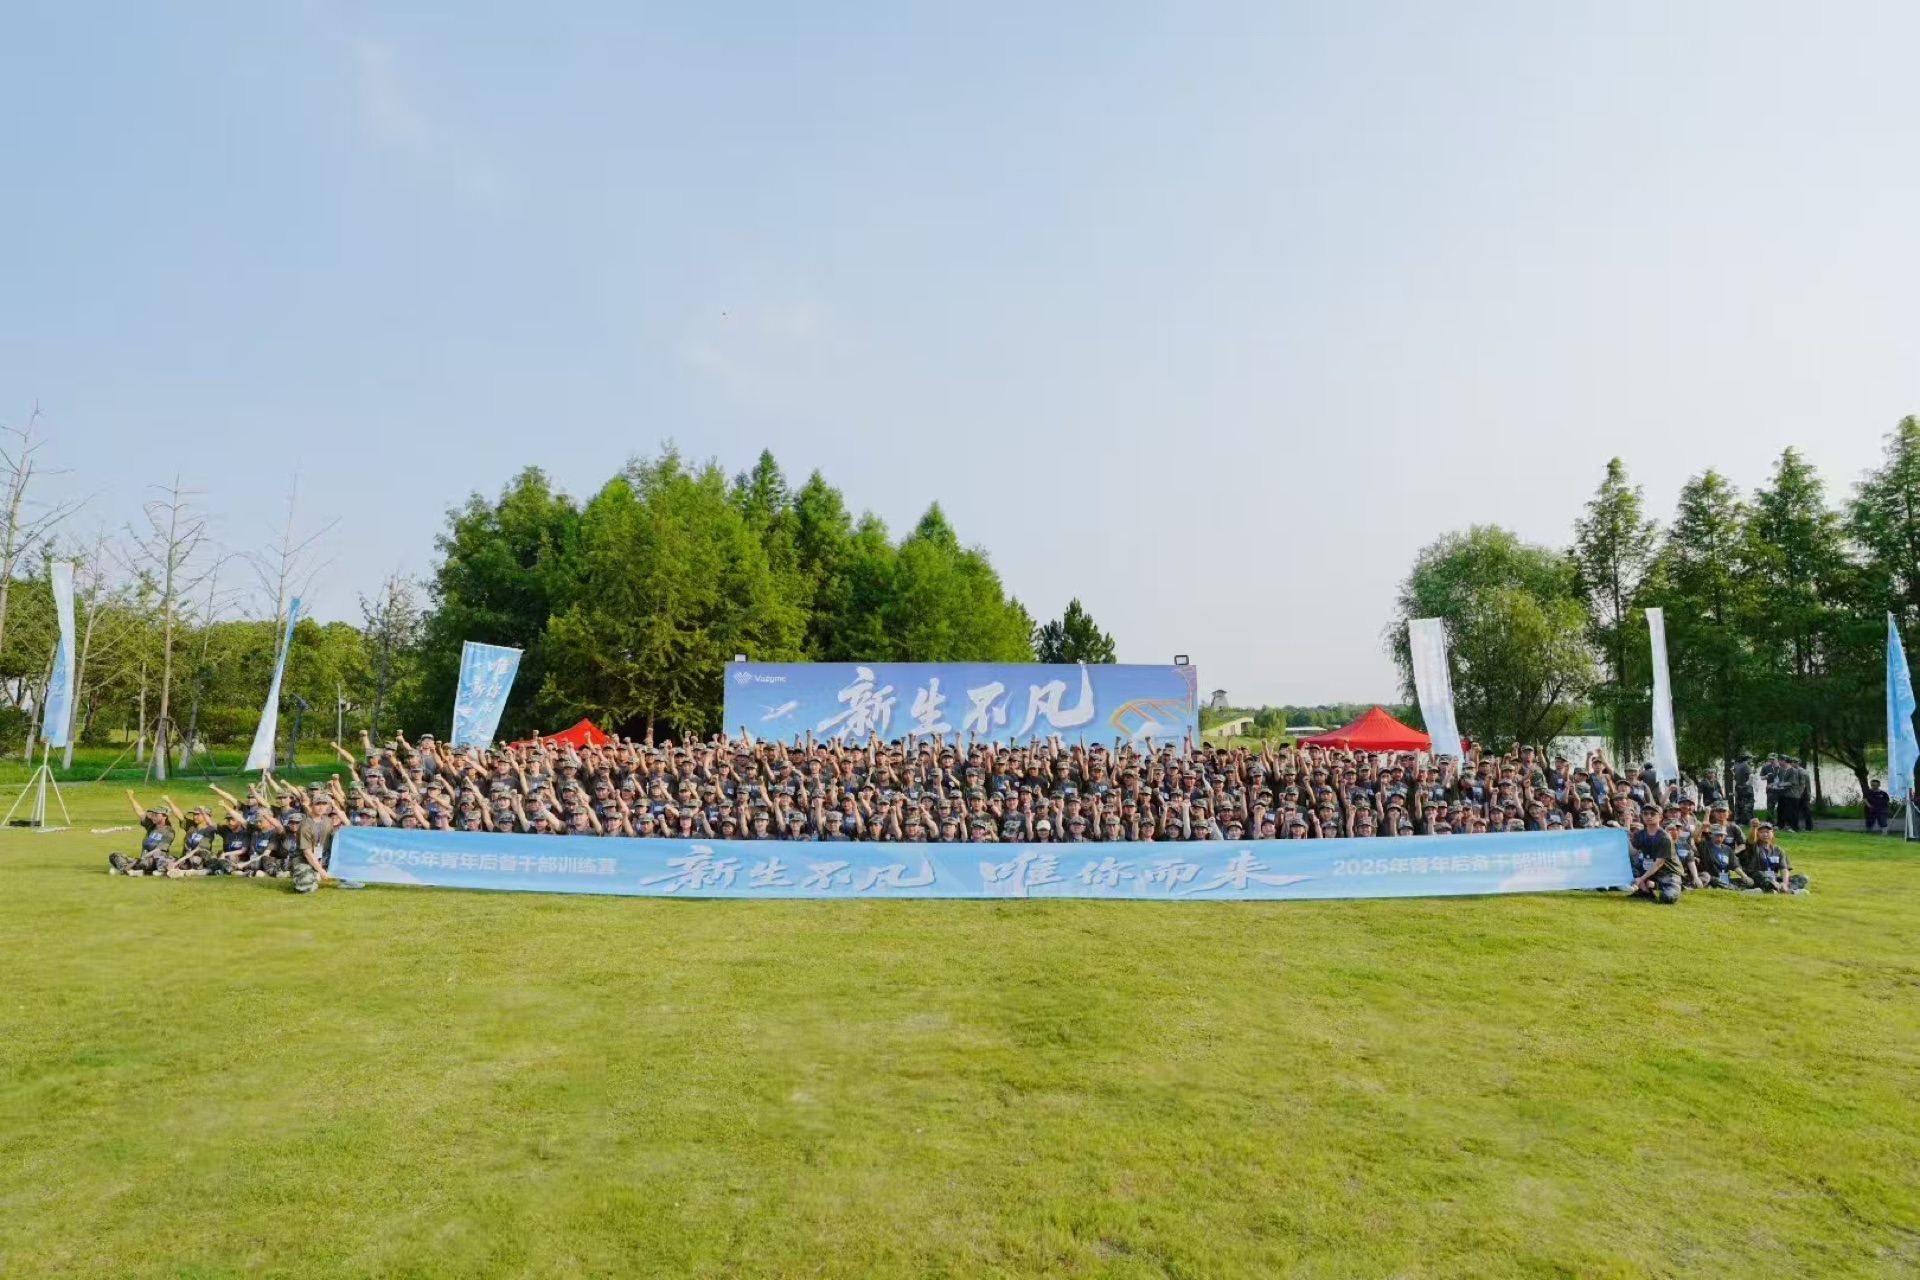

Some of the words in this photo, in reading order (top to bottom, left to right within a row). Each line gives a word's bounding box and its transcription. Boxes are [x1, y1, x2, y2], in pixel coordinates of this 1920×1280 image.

[817, 660, 1095, 741] 新生不凡
[640, 845, 936, 893] 新生不凡
